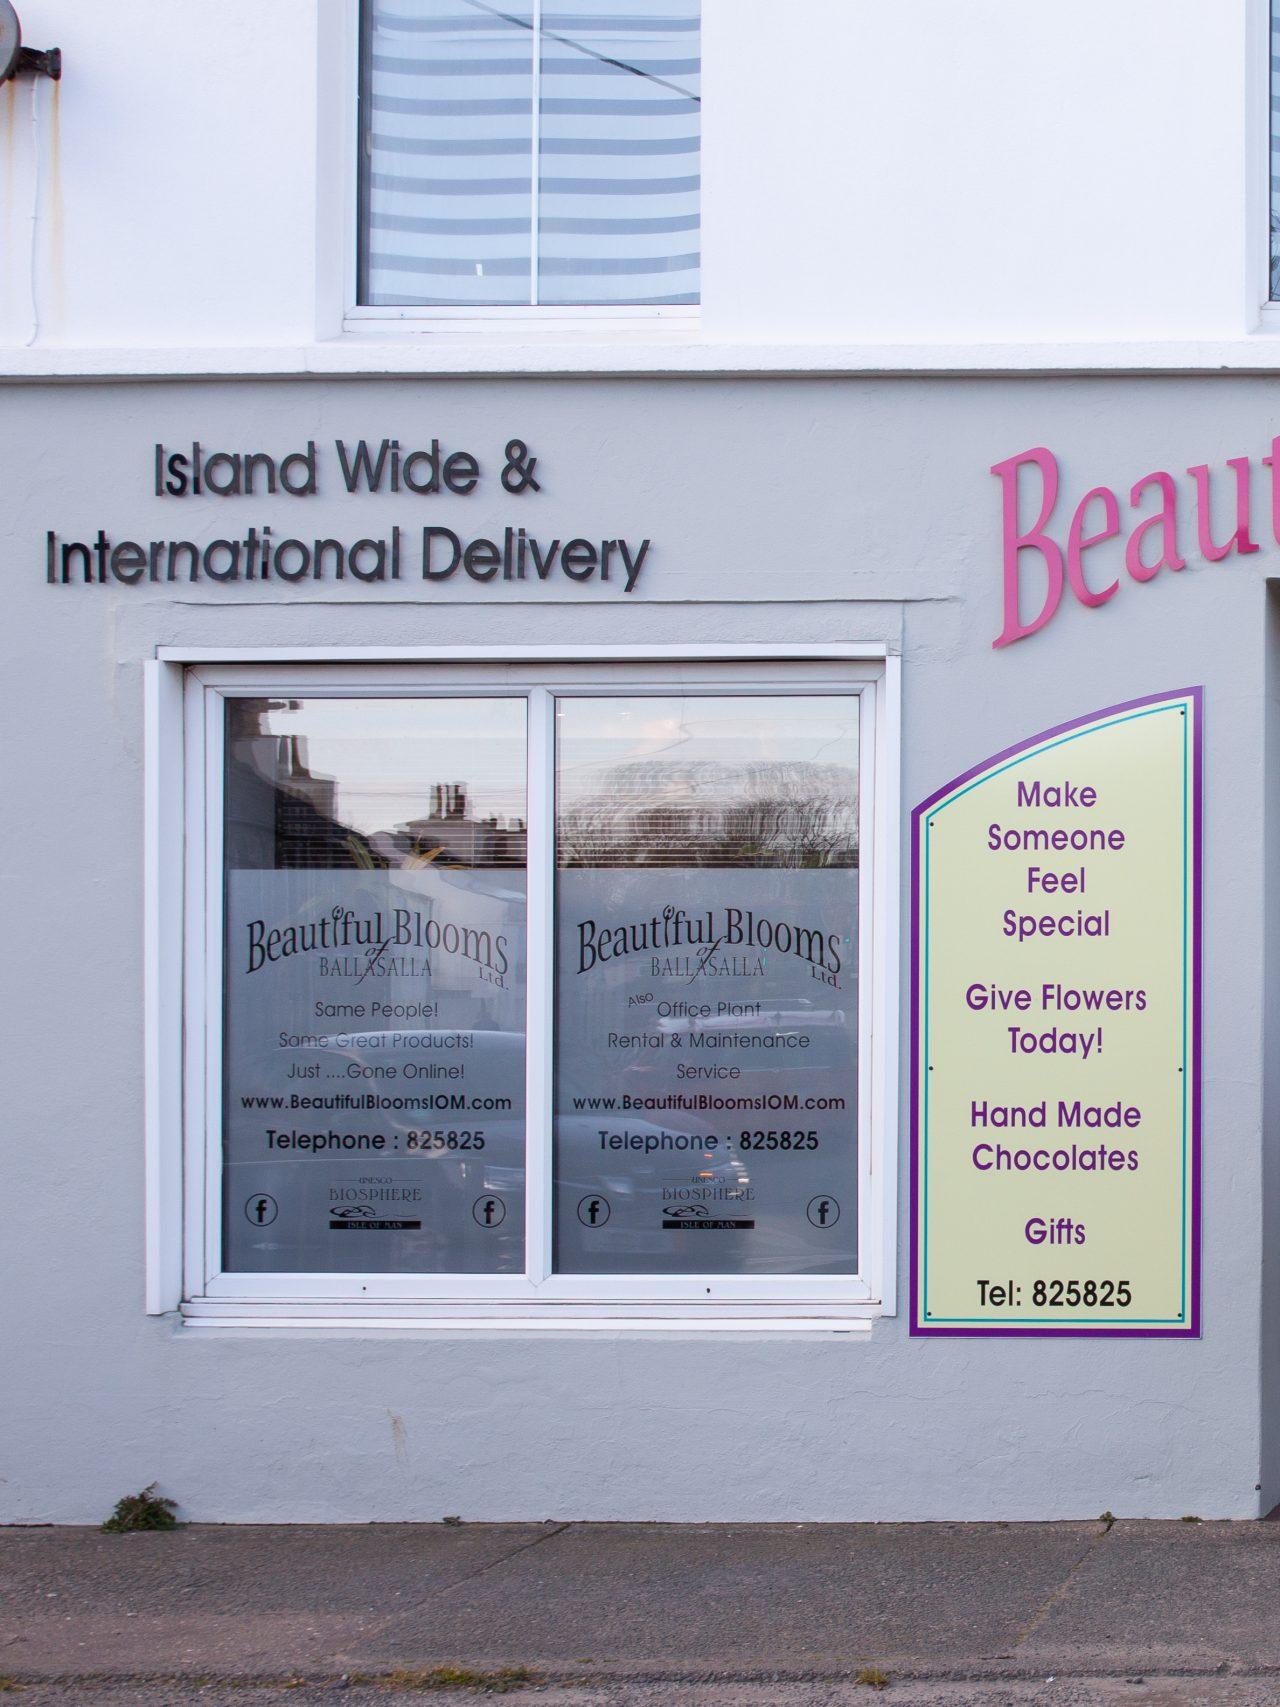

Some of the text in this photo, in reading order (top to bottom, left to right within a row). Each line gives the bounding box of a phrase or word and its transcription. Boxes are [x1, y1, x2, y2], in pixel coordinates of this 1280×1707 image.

[155, 438, 541, 497] Island Wide &
[46, 526, 651, 593] International Delivery
[1017, 781, 1097, 808] Make
[988, 823, 1125, 850] Someone
[1028, 867, 1085, 893] Feel
[1003, 909, 1109, 942] Special
[246, 905, 508, 975] Beautiful Blooms
[576, 904, 841, 975] Beautiful Blooms
[319, 956, 433, 977] BALLASALLA
[651, 956, 766, 977] BALLASALLA
[966, 983, 1147, 1010] Give Flowers
[315, 1001, 439, 1020] Same People!
[657, 1001, 762, 1018] Office Plant
[279, 1032, 474, 1048] Same Great Products!
[608, 1032, 811, 1048] Rental & Maintenance
[1008, 1027, 1103, 1059] Today!
[287, 1063, 321, 1079] Just
[403, 1063, 465, 1079] Online!
[676, 1063, 741, 1079] Service
[241, 1094, 512, 1110] www.BeautifulBloomsIOM.com
[573, 1094, 845, 1110] www.BeautifulBloomsIOM.com
[971, 1101, 1141, 1127] Hand Made
[266, 1129, 386, 1153] Telephone
[406, 1130, 486, 1150] 825825
[598, 1130, 719, 1153] Telephone
[739, 1130, 819, 1150] 825825
[972, 1143, 1139, 1171] Chocolates
[329, 1187, 422, 1202] BIOSPHERE
[662, 1187, 756, 1202] BIOSPHERE
[680, 1221, 700, 1229] ISLE
[1025, 1217, 1086, 1244] Gifts
[977, 1280, 1132, 1306] Tel: 825825
